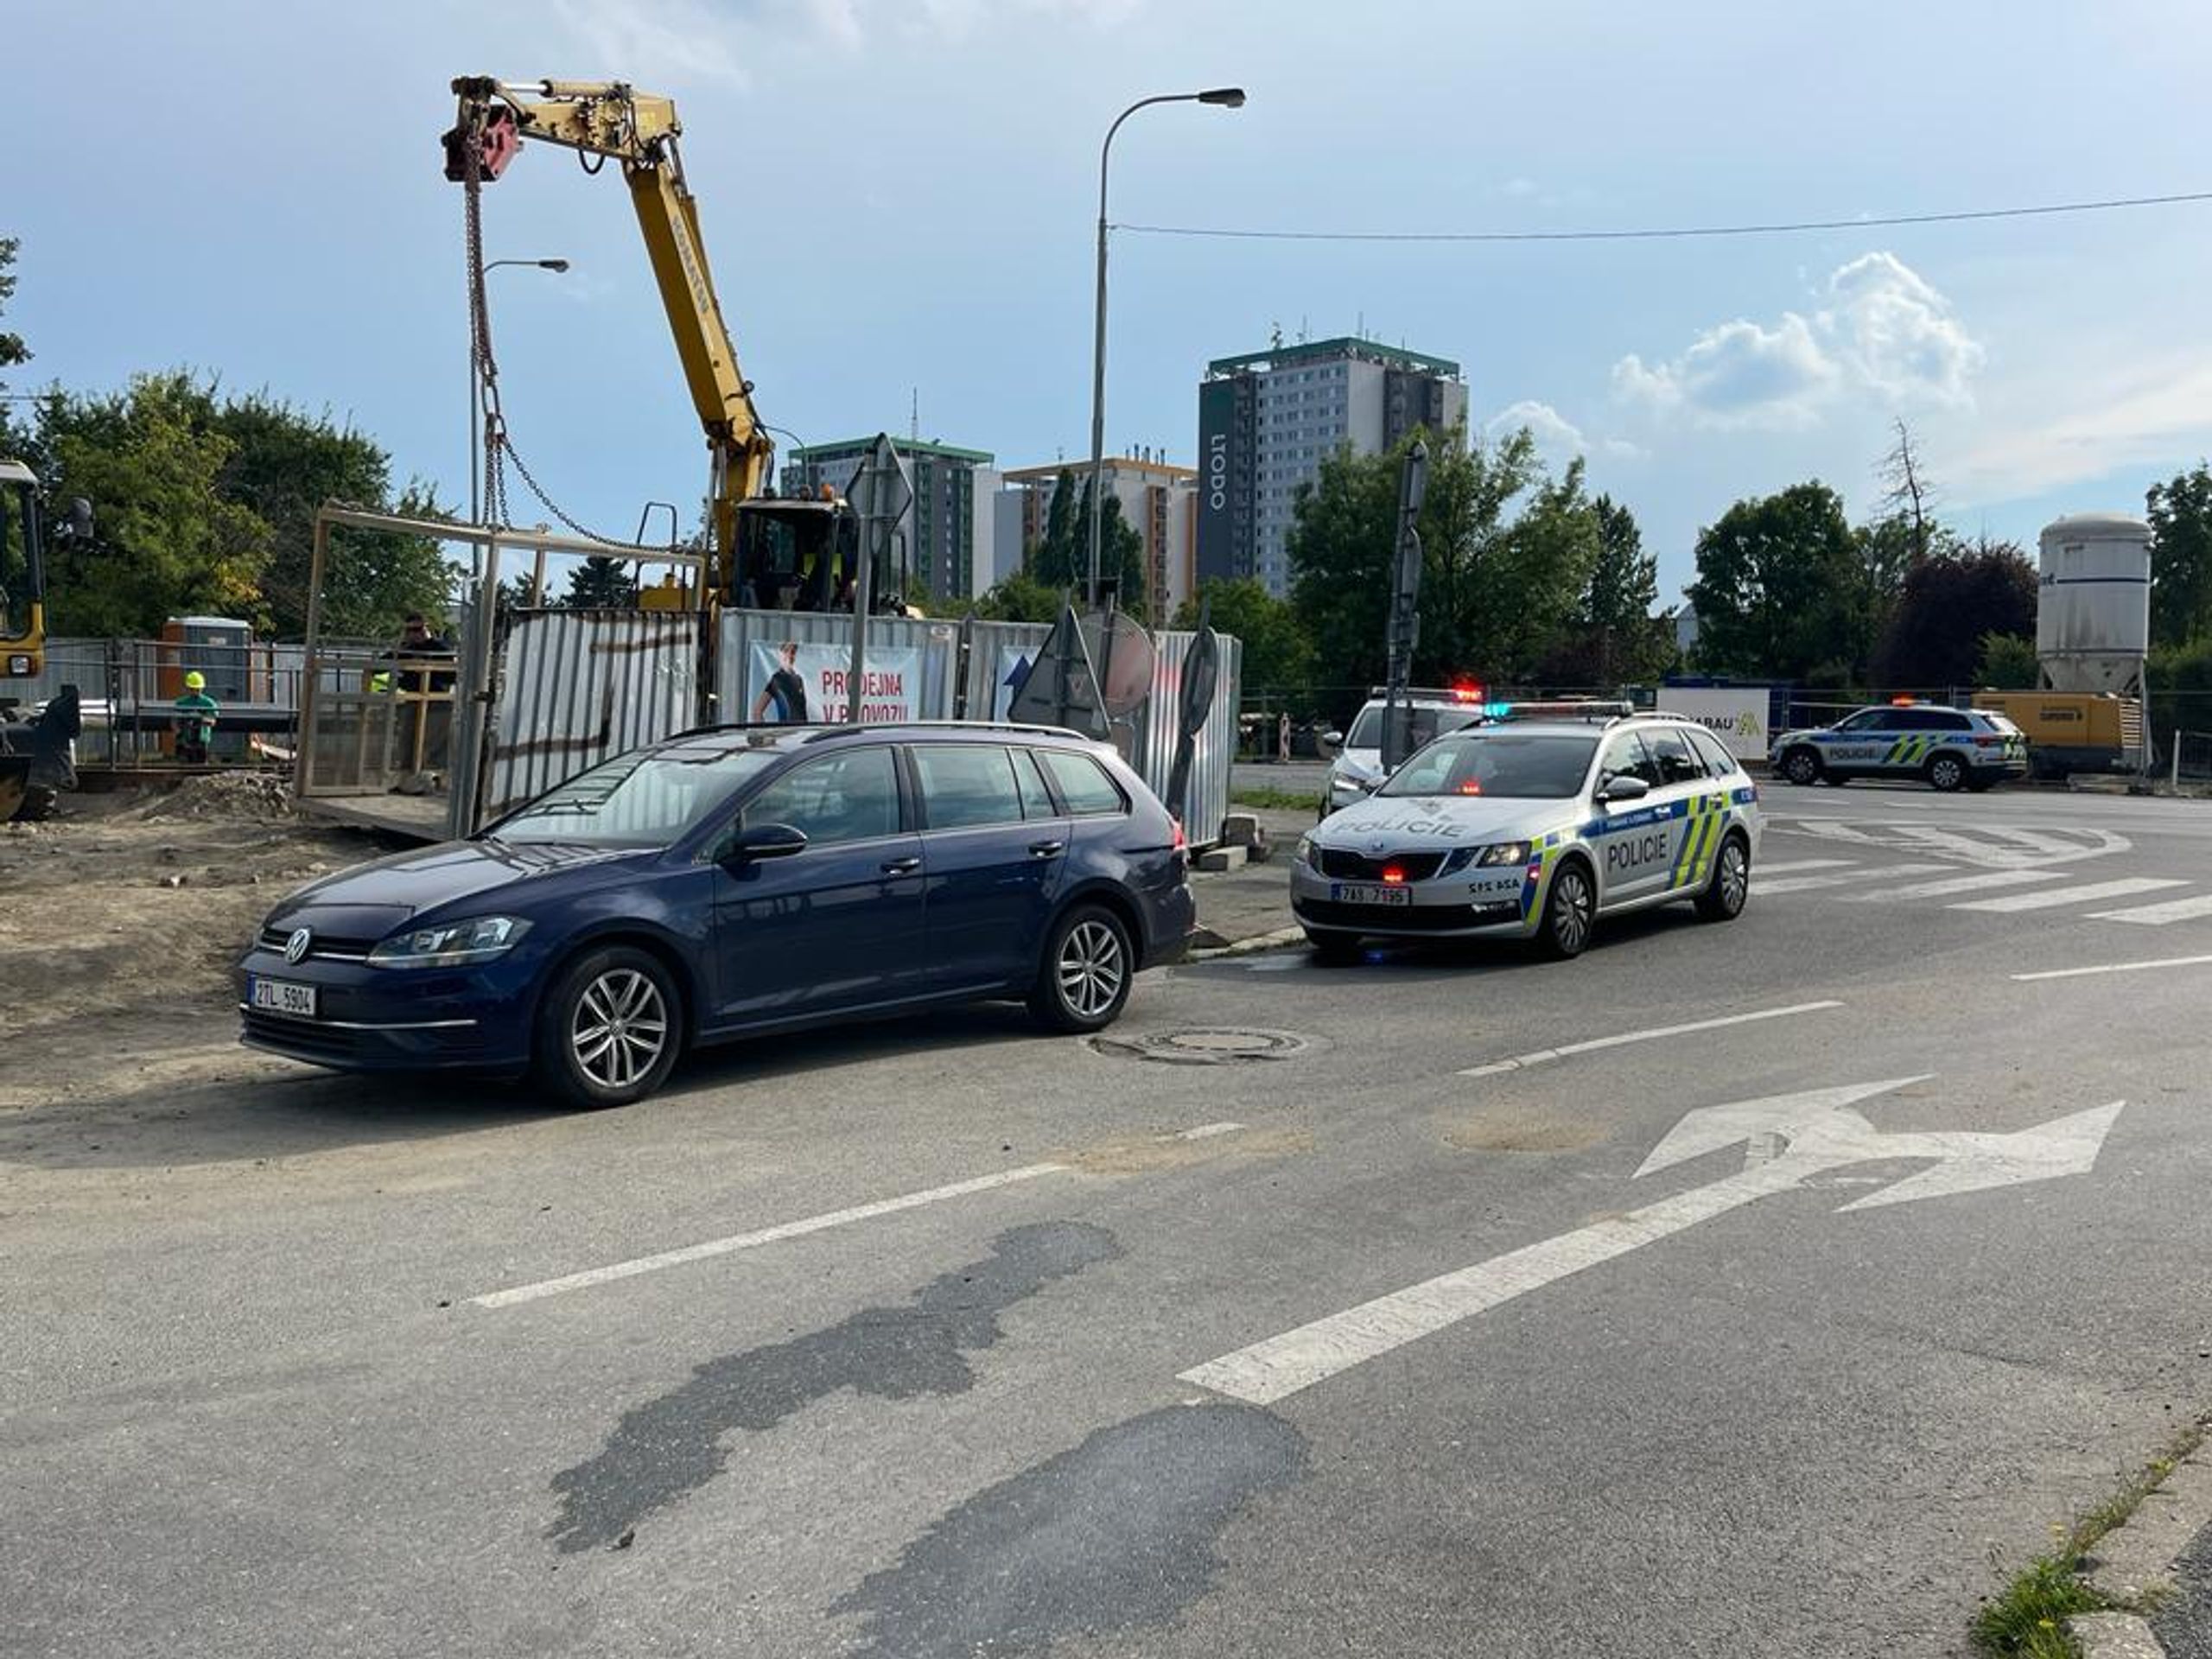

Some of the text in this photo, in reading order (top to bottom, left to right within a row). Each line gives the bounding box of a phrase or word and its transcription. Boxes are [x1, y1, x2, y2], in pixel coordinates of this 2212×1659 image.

[823, 704, 908, 724] V POVOZU
[1332, 820, 1469, 837] POLICIE
[1607, 834, 1668, 872] POLICIE
[257, 983, 311, 1012] 2TL 5904
